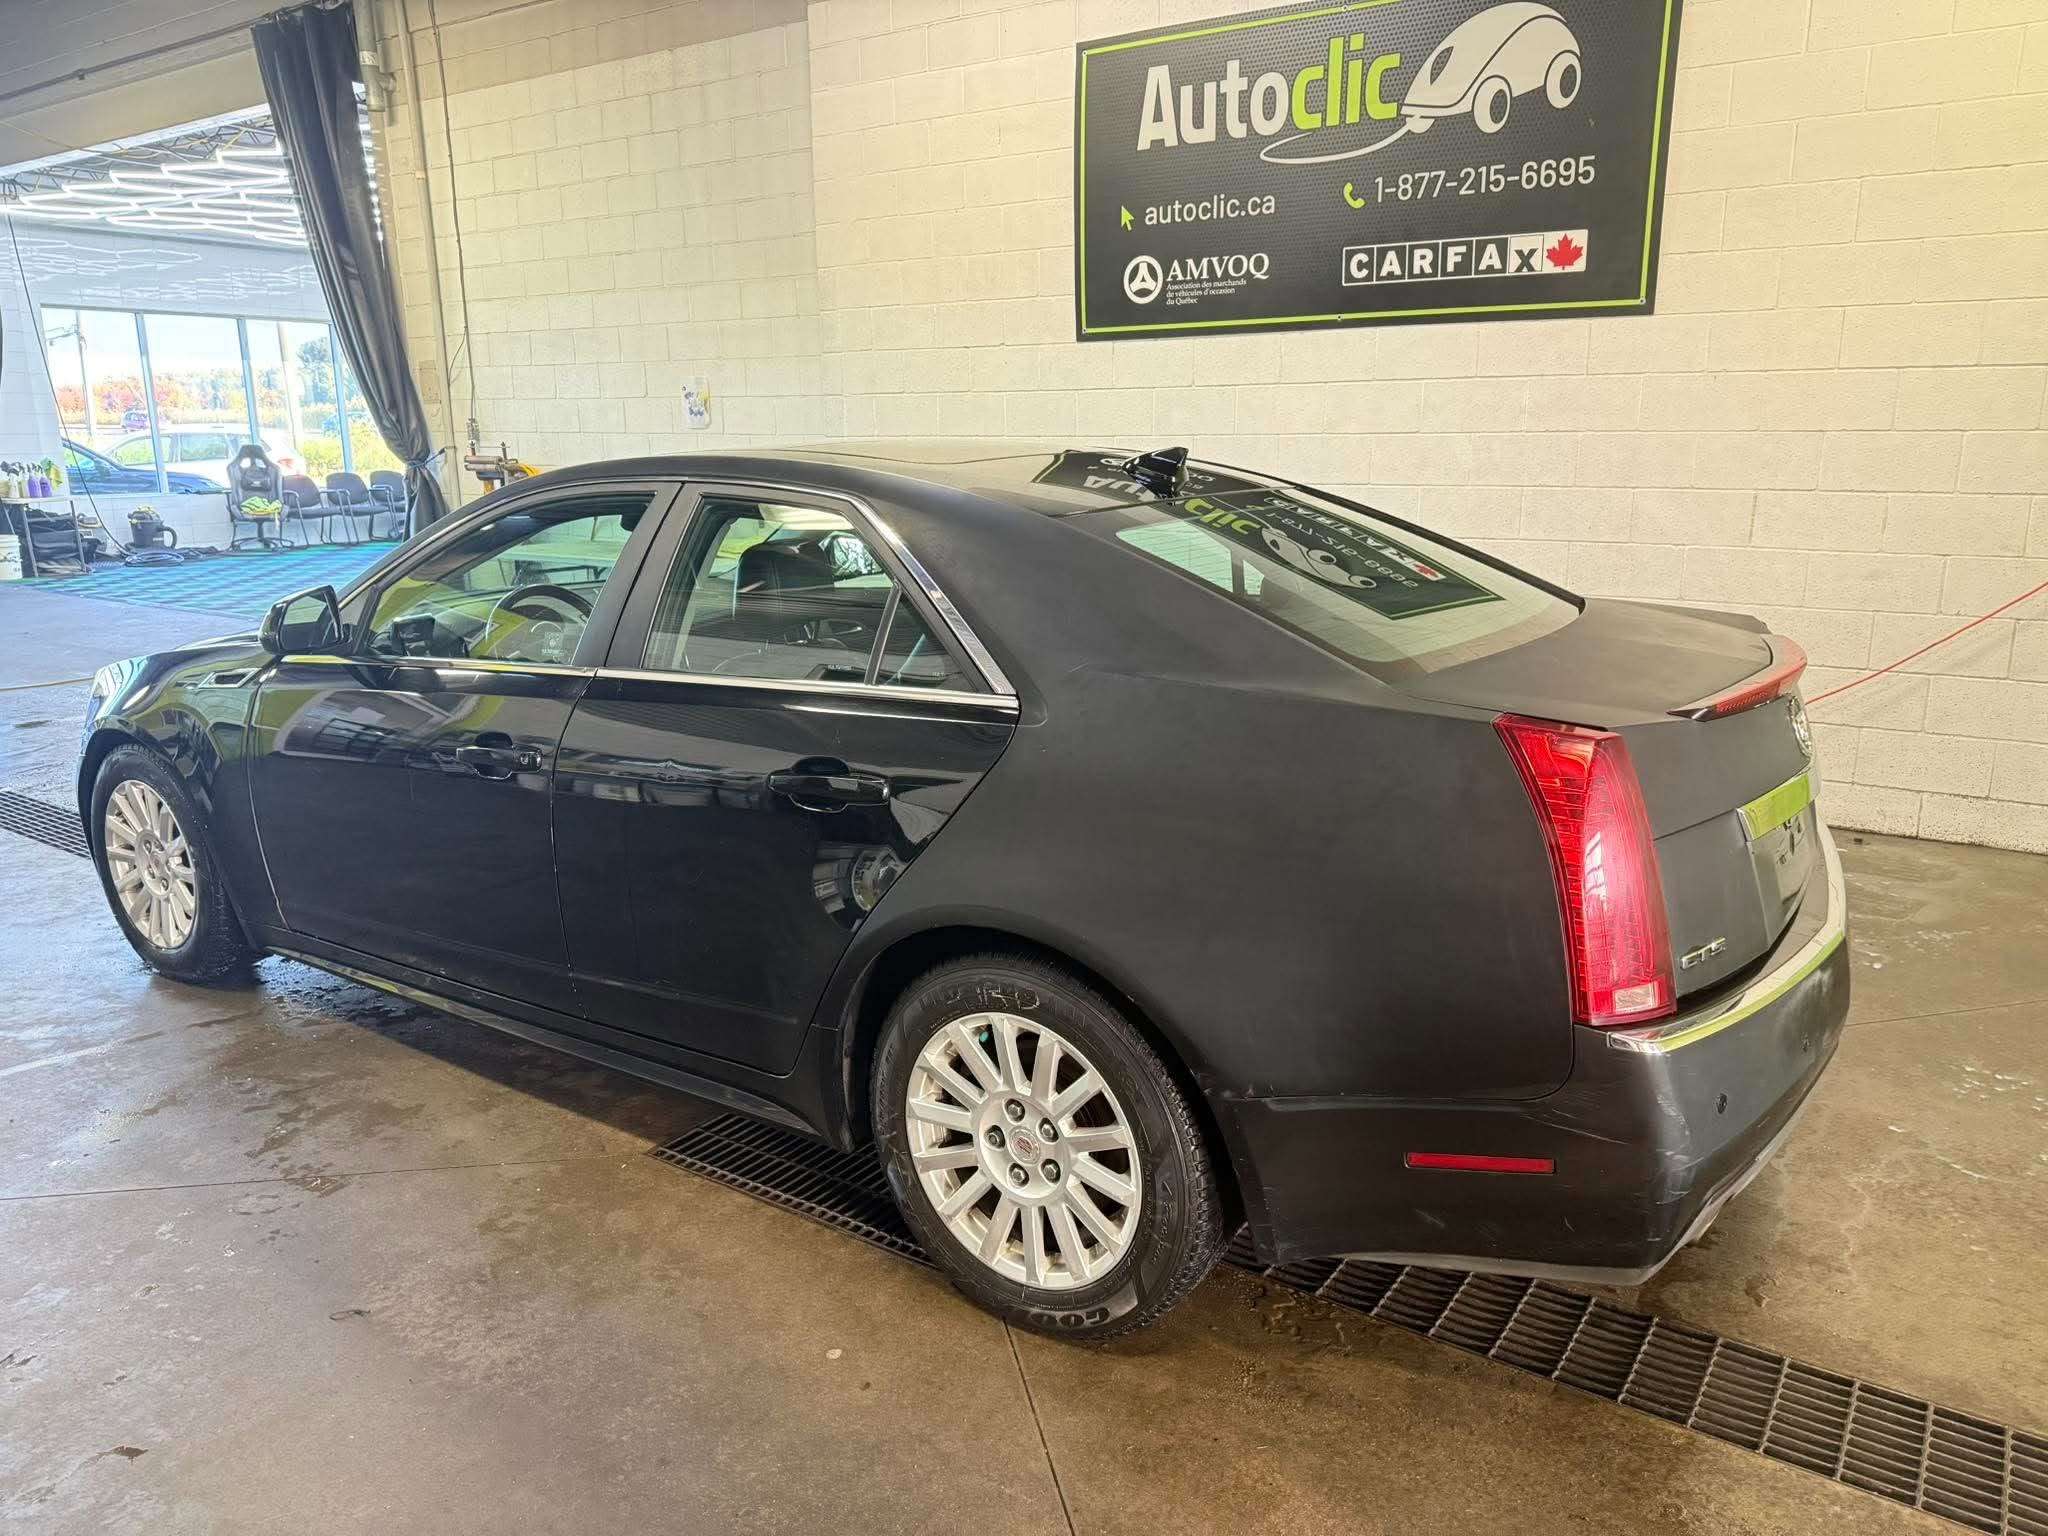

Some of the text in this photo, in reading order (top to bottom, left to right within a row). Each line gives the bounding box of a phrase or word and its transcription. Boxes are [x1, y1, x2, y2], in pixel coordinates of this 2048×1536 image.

[1137, 32, 1401, 151] Autoclic
[1374, 155, 1596, 203] 1-877-215-6695
[1144, 193, 1276, 226] autoclic.ca
[1166, 252, 1271, 282] AMVOQ
[1350, 243, 1539, 279] CARFAX
[1166, 278, 1247, 291] Association des marchands
[1166, 290, 1175, 298] de
[1203, 287, 1236, 296] d'occasion
[1166, 297, 1175, 305] du
[1680, 936, 1726, 970] CTS
